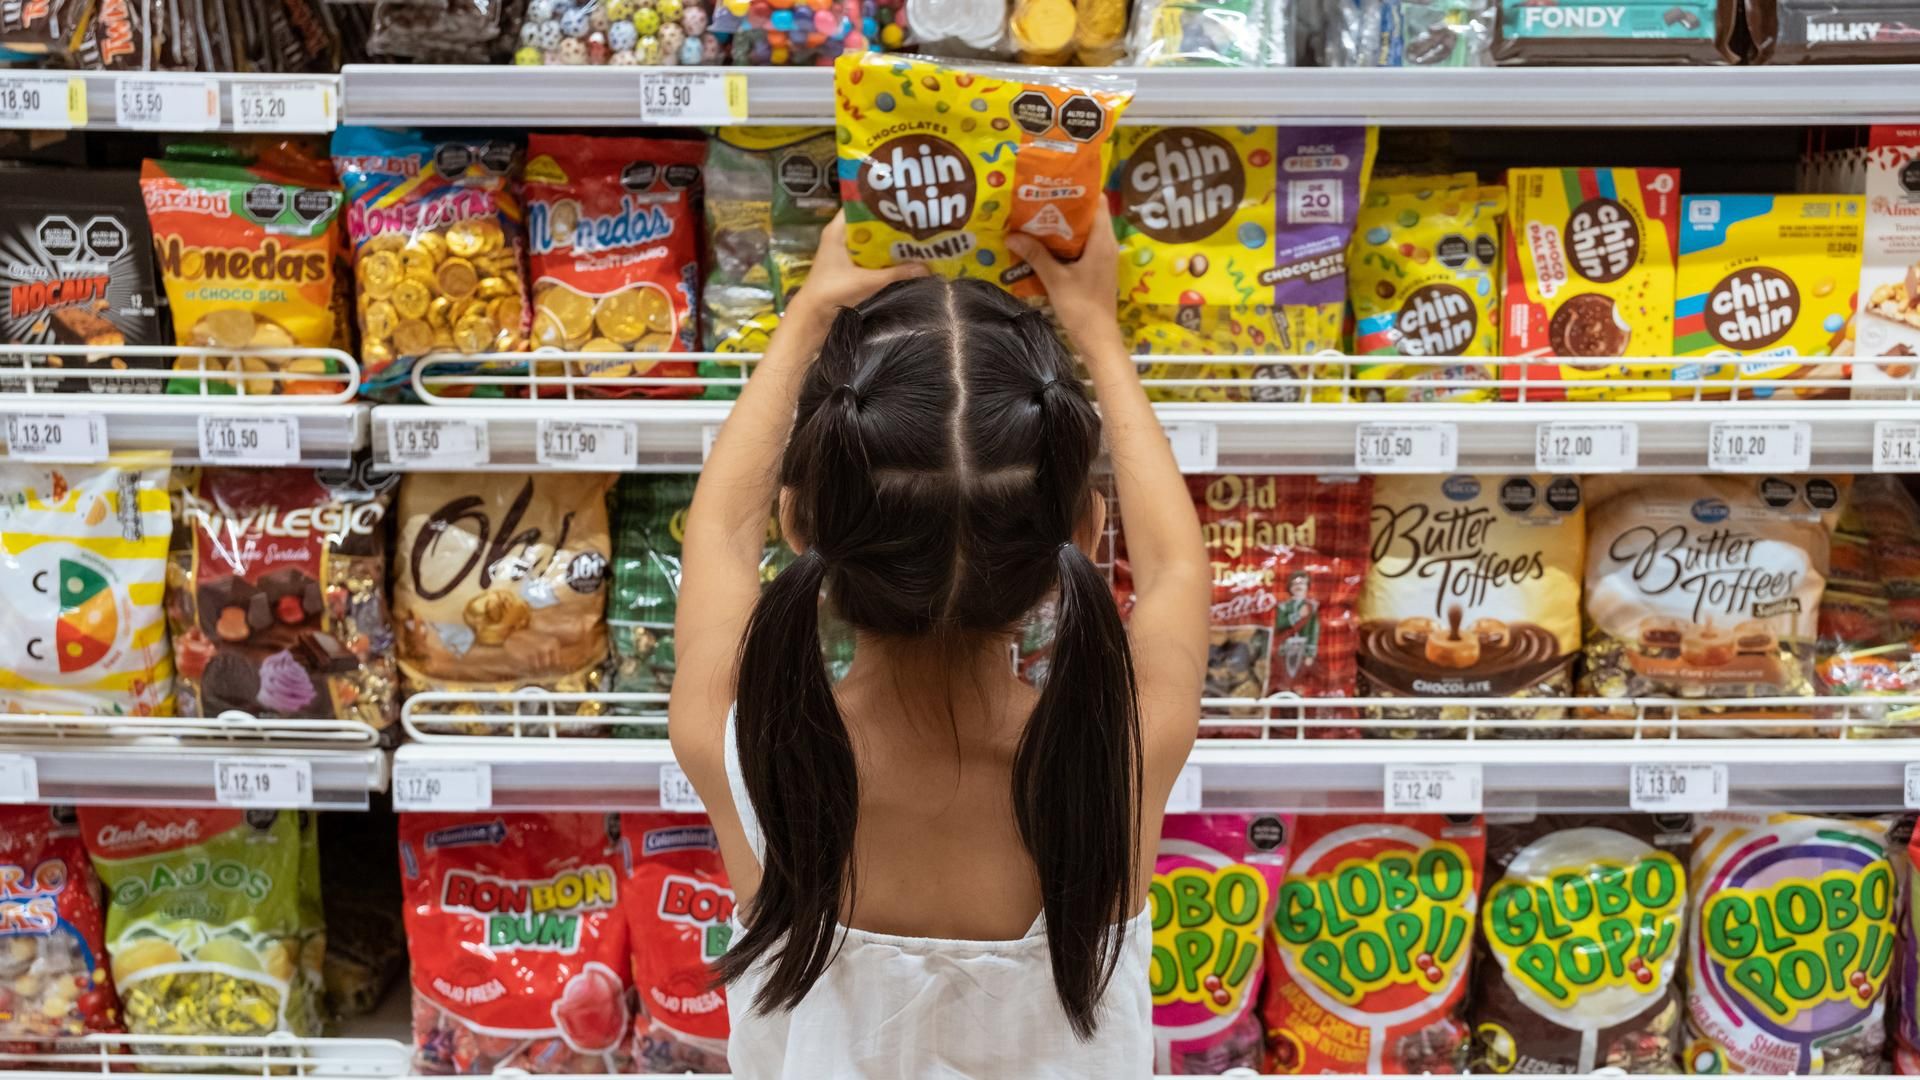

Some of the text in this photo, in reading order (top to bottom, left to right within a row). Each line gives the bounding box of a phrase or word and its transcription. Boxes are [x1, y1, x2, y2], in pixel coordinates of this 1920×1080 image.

[1525, 6, 1626, 29] FONDY
[1806, 22, 1881, 42] MILKY
[866, 120, 949, 147] CHOCOLATES
[867, 143, 967, 191] chin
[1131, 137, 1231, 192] chin
[1288, 157, 1344, 168] FIESTA
[878, 186, 968, 230] chin
[1023, 187, 1080, 199] FIESTA
[1130, 180, 1234, 230] chin
[1301, 193, 1331, 208] 20
[156, 238, 327, 282] Monedas
[1545, 229, 1565, 281] CHOCO
[1572, 212, 1607, 278] chin
[1597, 204, 1634, 274] chin
[1262, 252, 1345, 283] CHOCOLATE
[1309, 264, 1346, 281] REAL
[11, 275, 110, 320] NOCAUT
[200, 288, 253, 302] CHOCO
[258, 288, 288, 302] SOL
[1400, 289, 1469, 333] chin
[1712, 272, 1791, 315] chin
[1405, 317, 1473, 357] chin
[1718, 303, 1793, 342] chin
[1204, 474, 1277, 512] Old
[1201, 515, 1316, 558] ngland
[1370, 503, 1497, 579] Butter
[1609, 524, 1761, 596] Butter
[1417, 549, 1544, 619] Toffees
[1680, 566, 1798, 625] Toffees
[1412, 679, 1491, 695] CHOCOLATE
[112, 859, 272, 908] GAJOS
[446, 870, 613, 913] BON BON
[1150, 872, 1260, 932] OBO
[1275, 847, 1465, 944] GLOBO
[1490, 856, 1677, 948] GLOBO
[489, 914, 579, 949] BUM
[1707, 867, 1892, 960] GLOBO
[1301, 904, 1468, 998] POP!!
[1516, 911, 1677, 1001] POP!!
[1735, 923, 1895, 1015] POP!!
[465, 978, 507, 1005] FRESA
[681, 989, 726, 1014] FRESA
[1320, 1013, 1371, 1048] CHICLE
[1750, 1034, 1798, 1061] SHAKE
